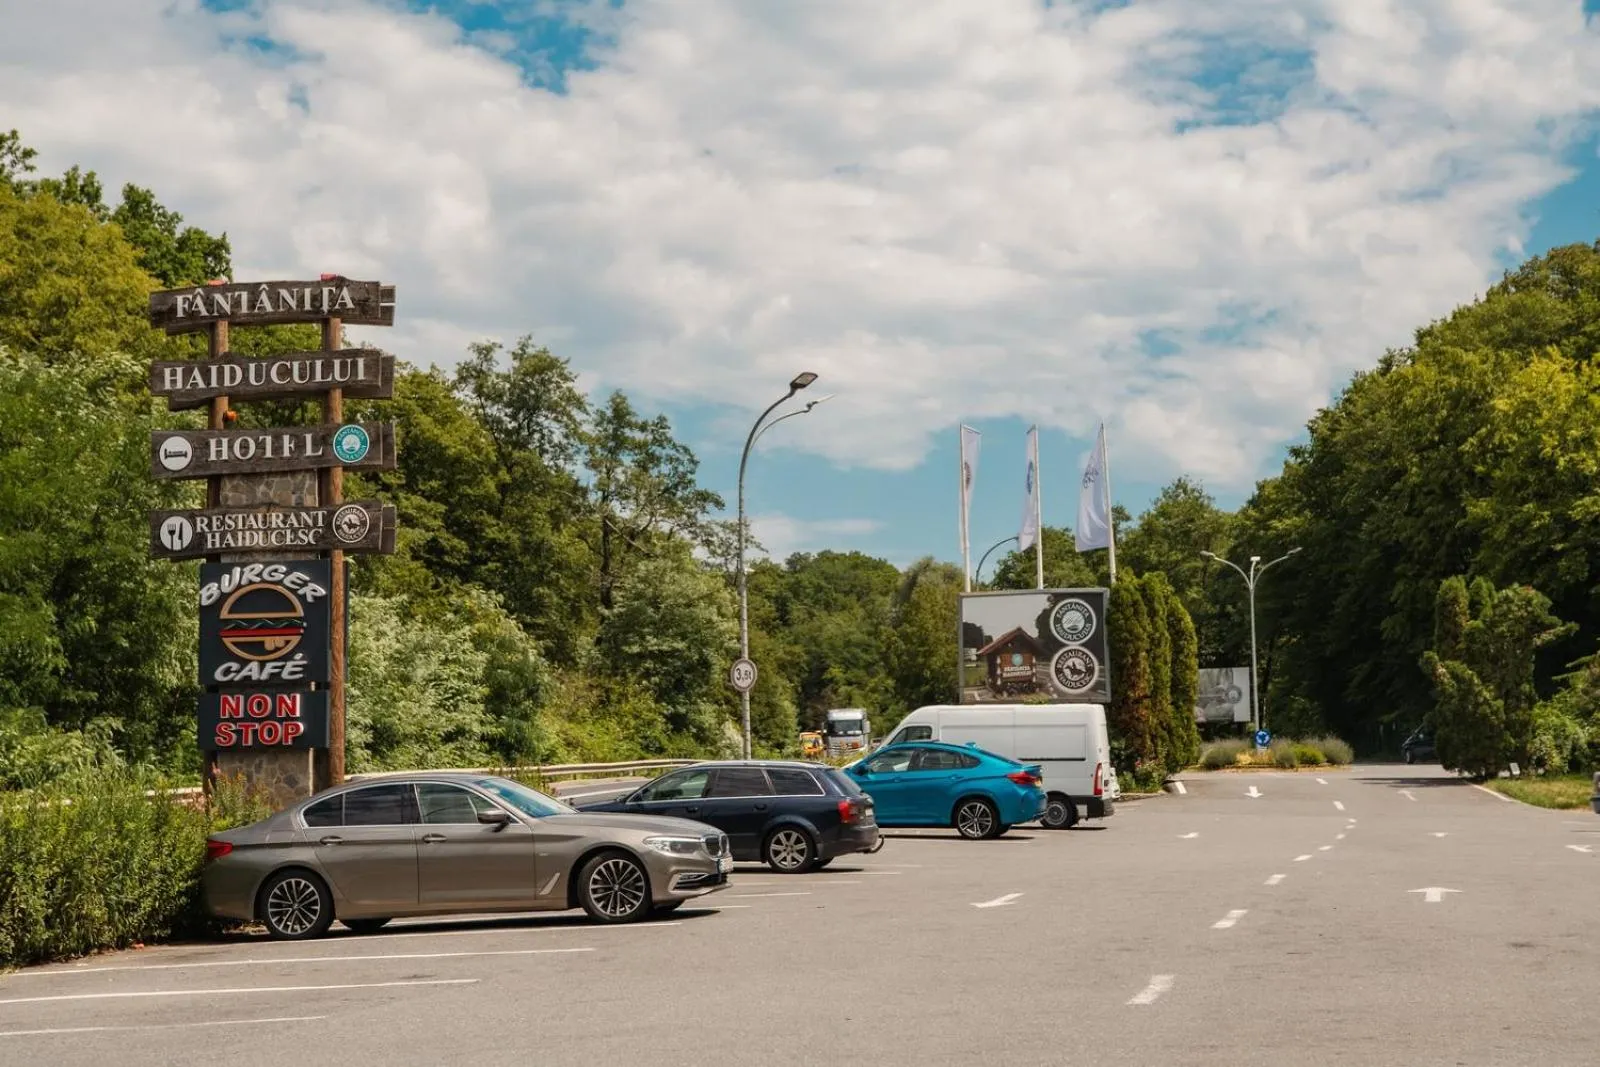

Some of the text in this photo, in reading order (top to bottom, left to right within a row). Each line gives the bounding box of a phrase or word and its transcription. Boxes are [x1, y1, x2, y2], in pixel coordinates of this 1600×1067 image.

[163, 357, 367, 391] HAIDUCULUI
[195, 510, 327, 534] RESTAURANT
[206, 528, 323, 549] HAIDUCESC
[199, 563, 327, 607] BURGER
[214, 653, 308, 682] CAFÉ
[220, 693, 300, 718] NON
[215, 721, 304, 747] STOP
